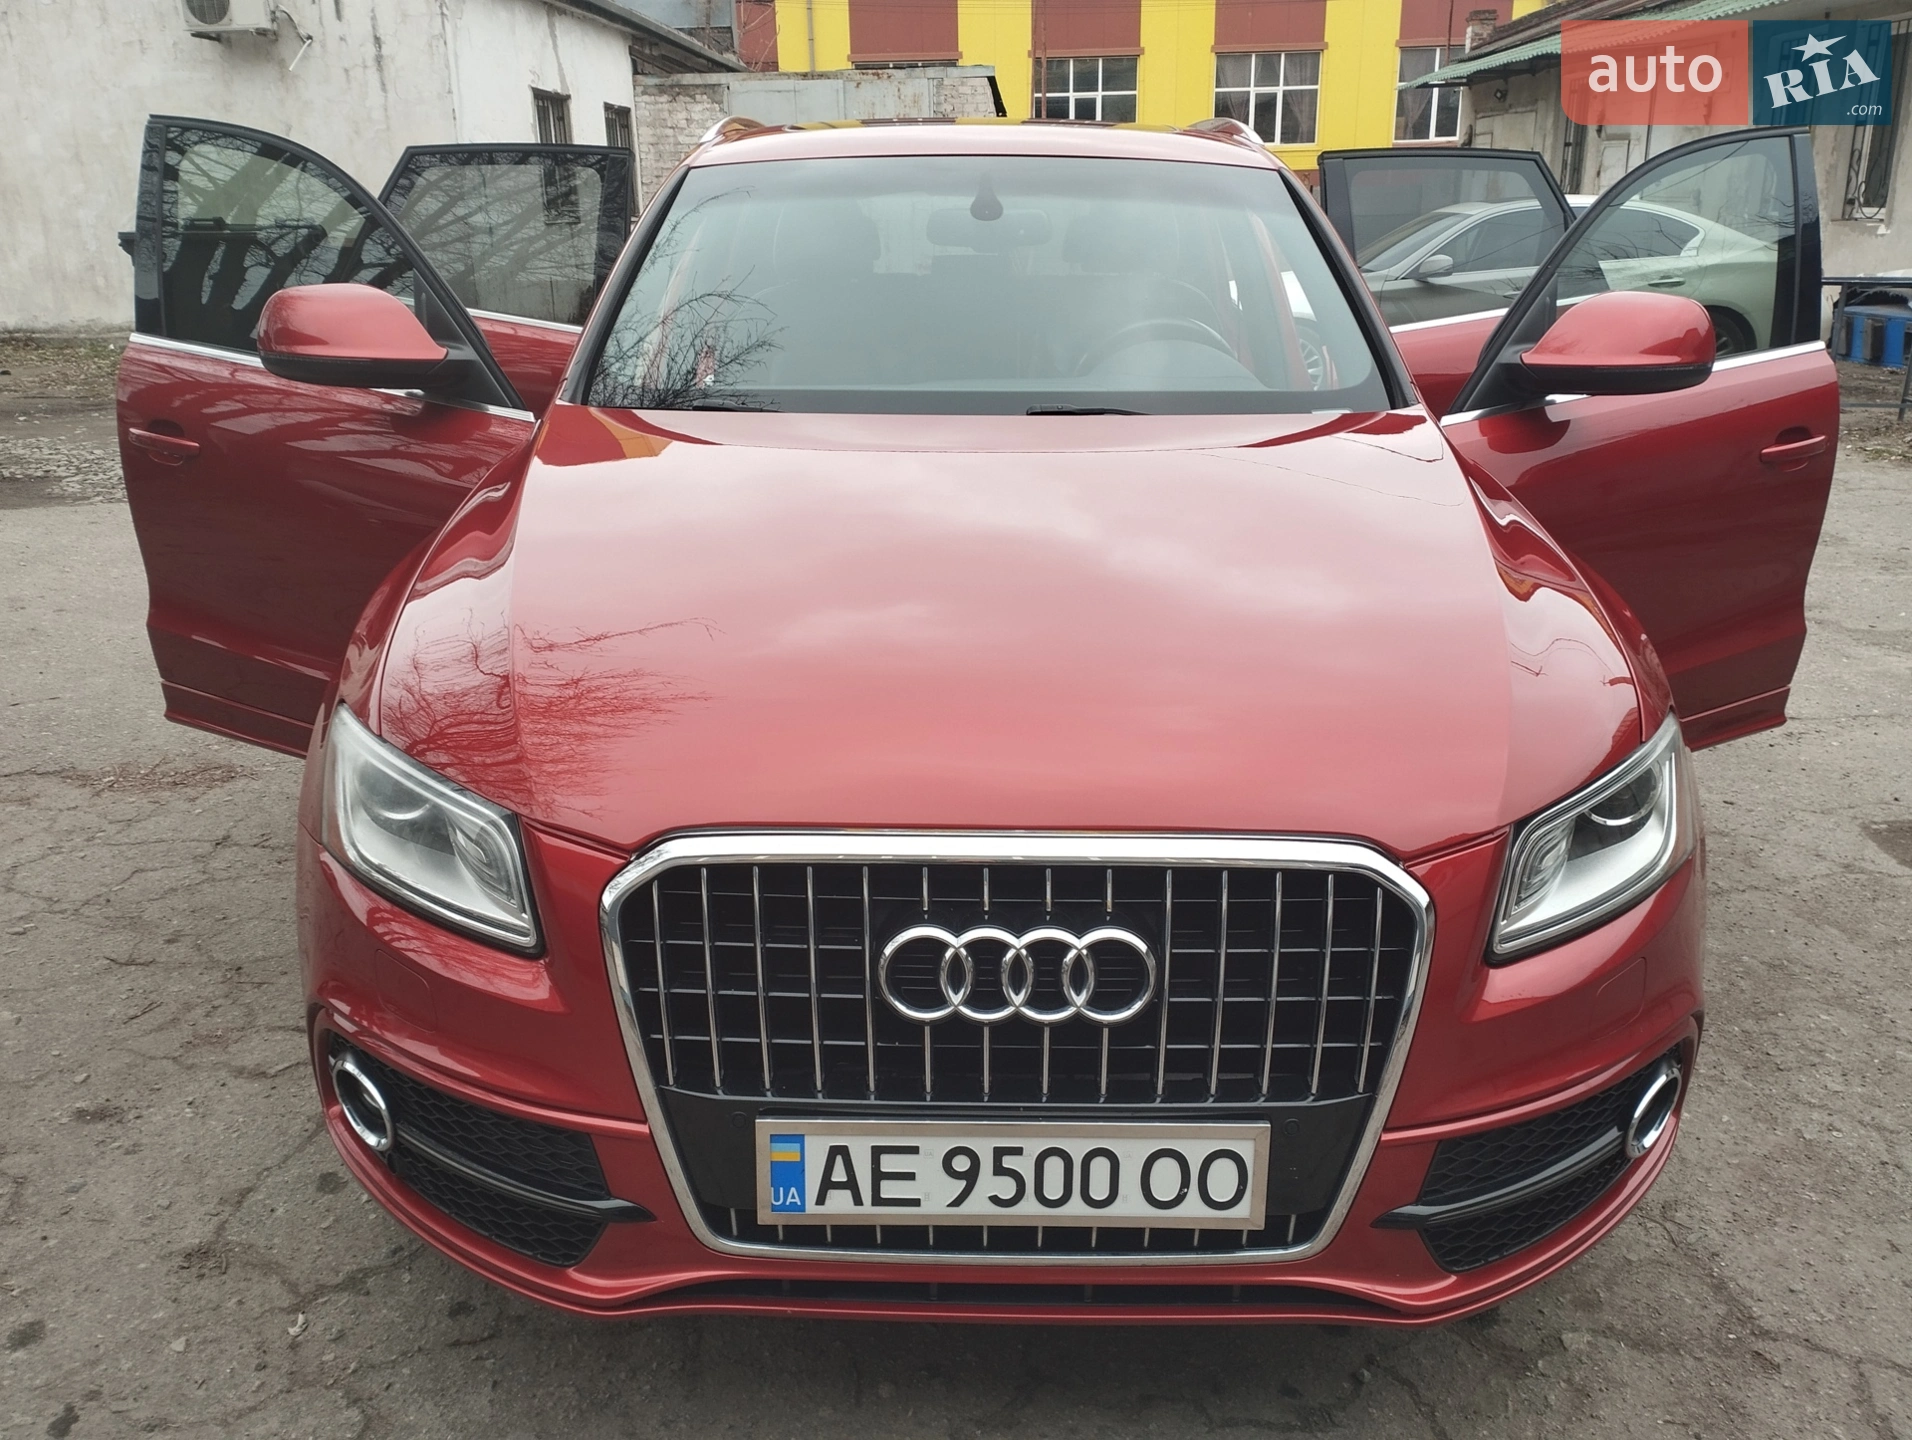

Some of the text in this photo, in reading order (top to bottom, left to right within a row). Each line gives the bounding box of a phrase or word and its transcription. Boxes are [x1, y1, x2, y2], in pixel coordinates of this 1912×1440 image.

[771, 1186, 802, 1206] UA
[815, 1144, 1248, 1211] AE 9500 OO
